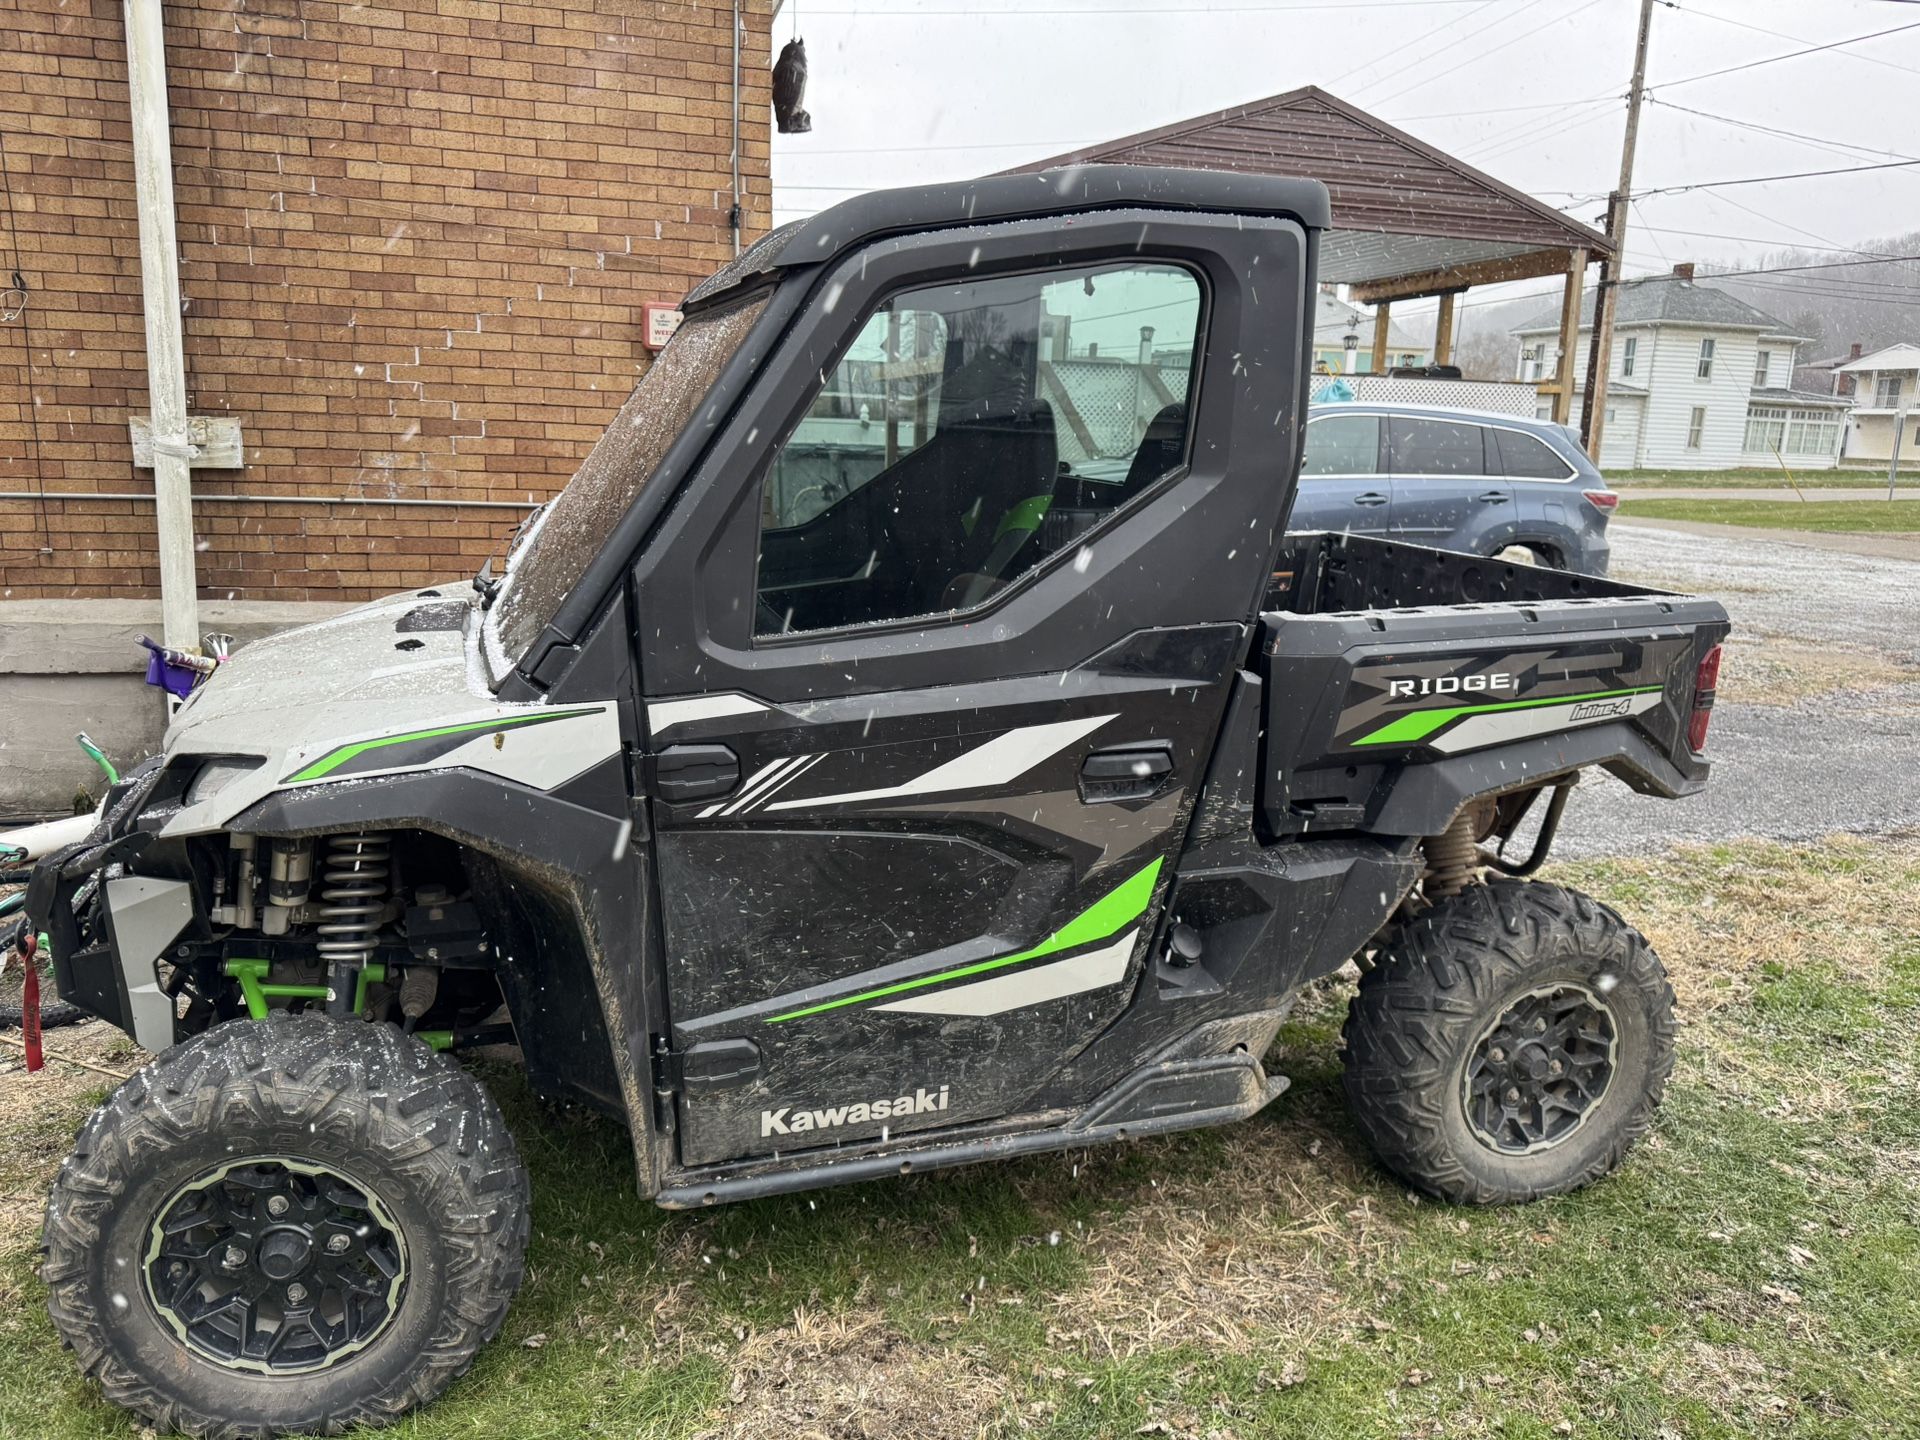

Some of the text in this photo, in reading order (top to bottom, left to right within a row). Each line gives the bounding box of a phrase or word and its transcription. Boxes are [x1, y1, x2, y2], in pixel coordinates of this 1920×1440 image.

[1389, 673, 1510, 697] RIDGE
[1569, 698, 1631, 721] Inline-4
[761, 1085, 949, 1137] Kawasaki
